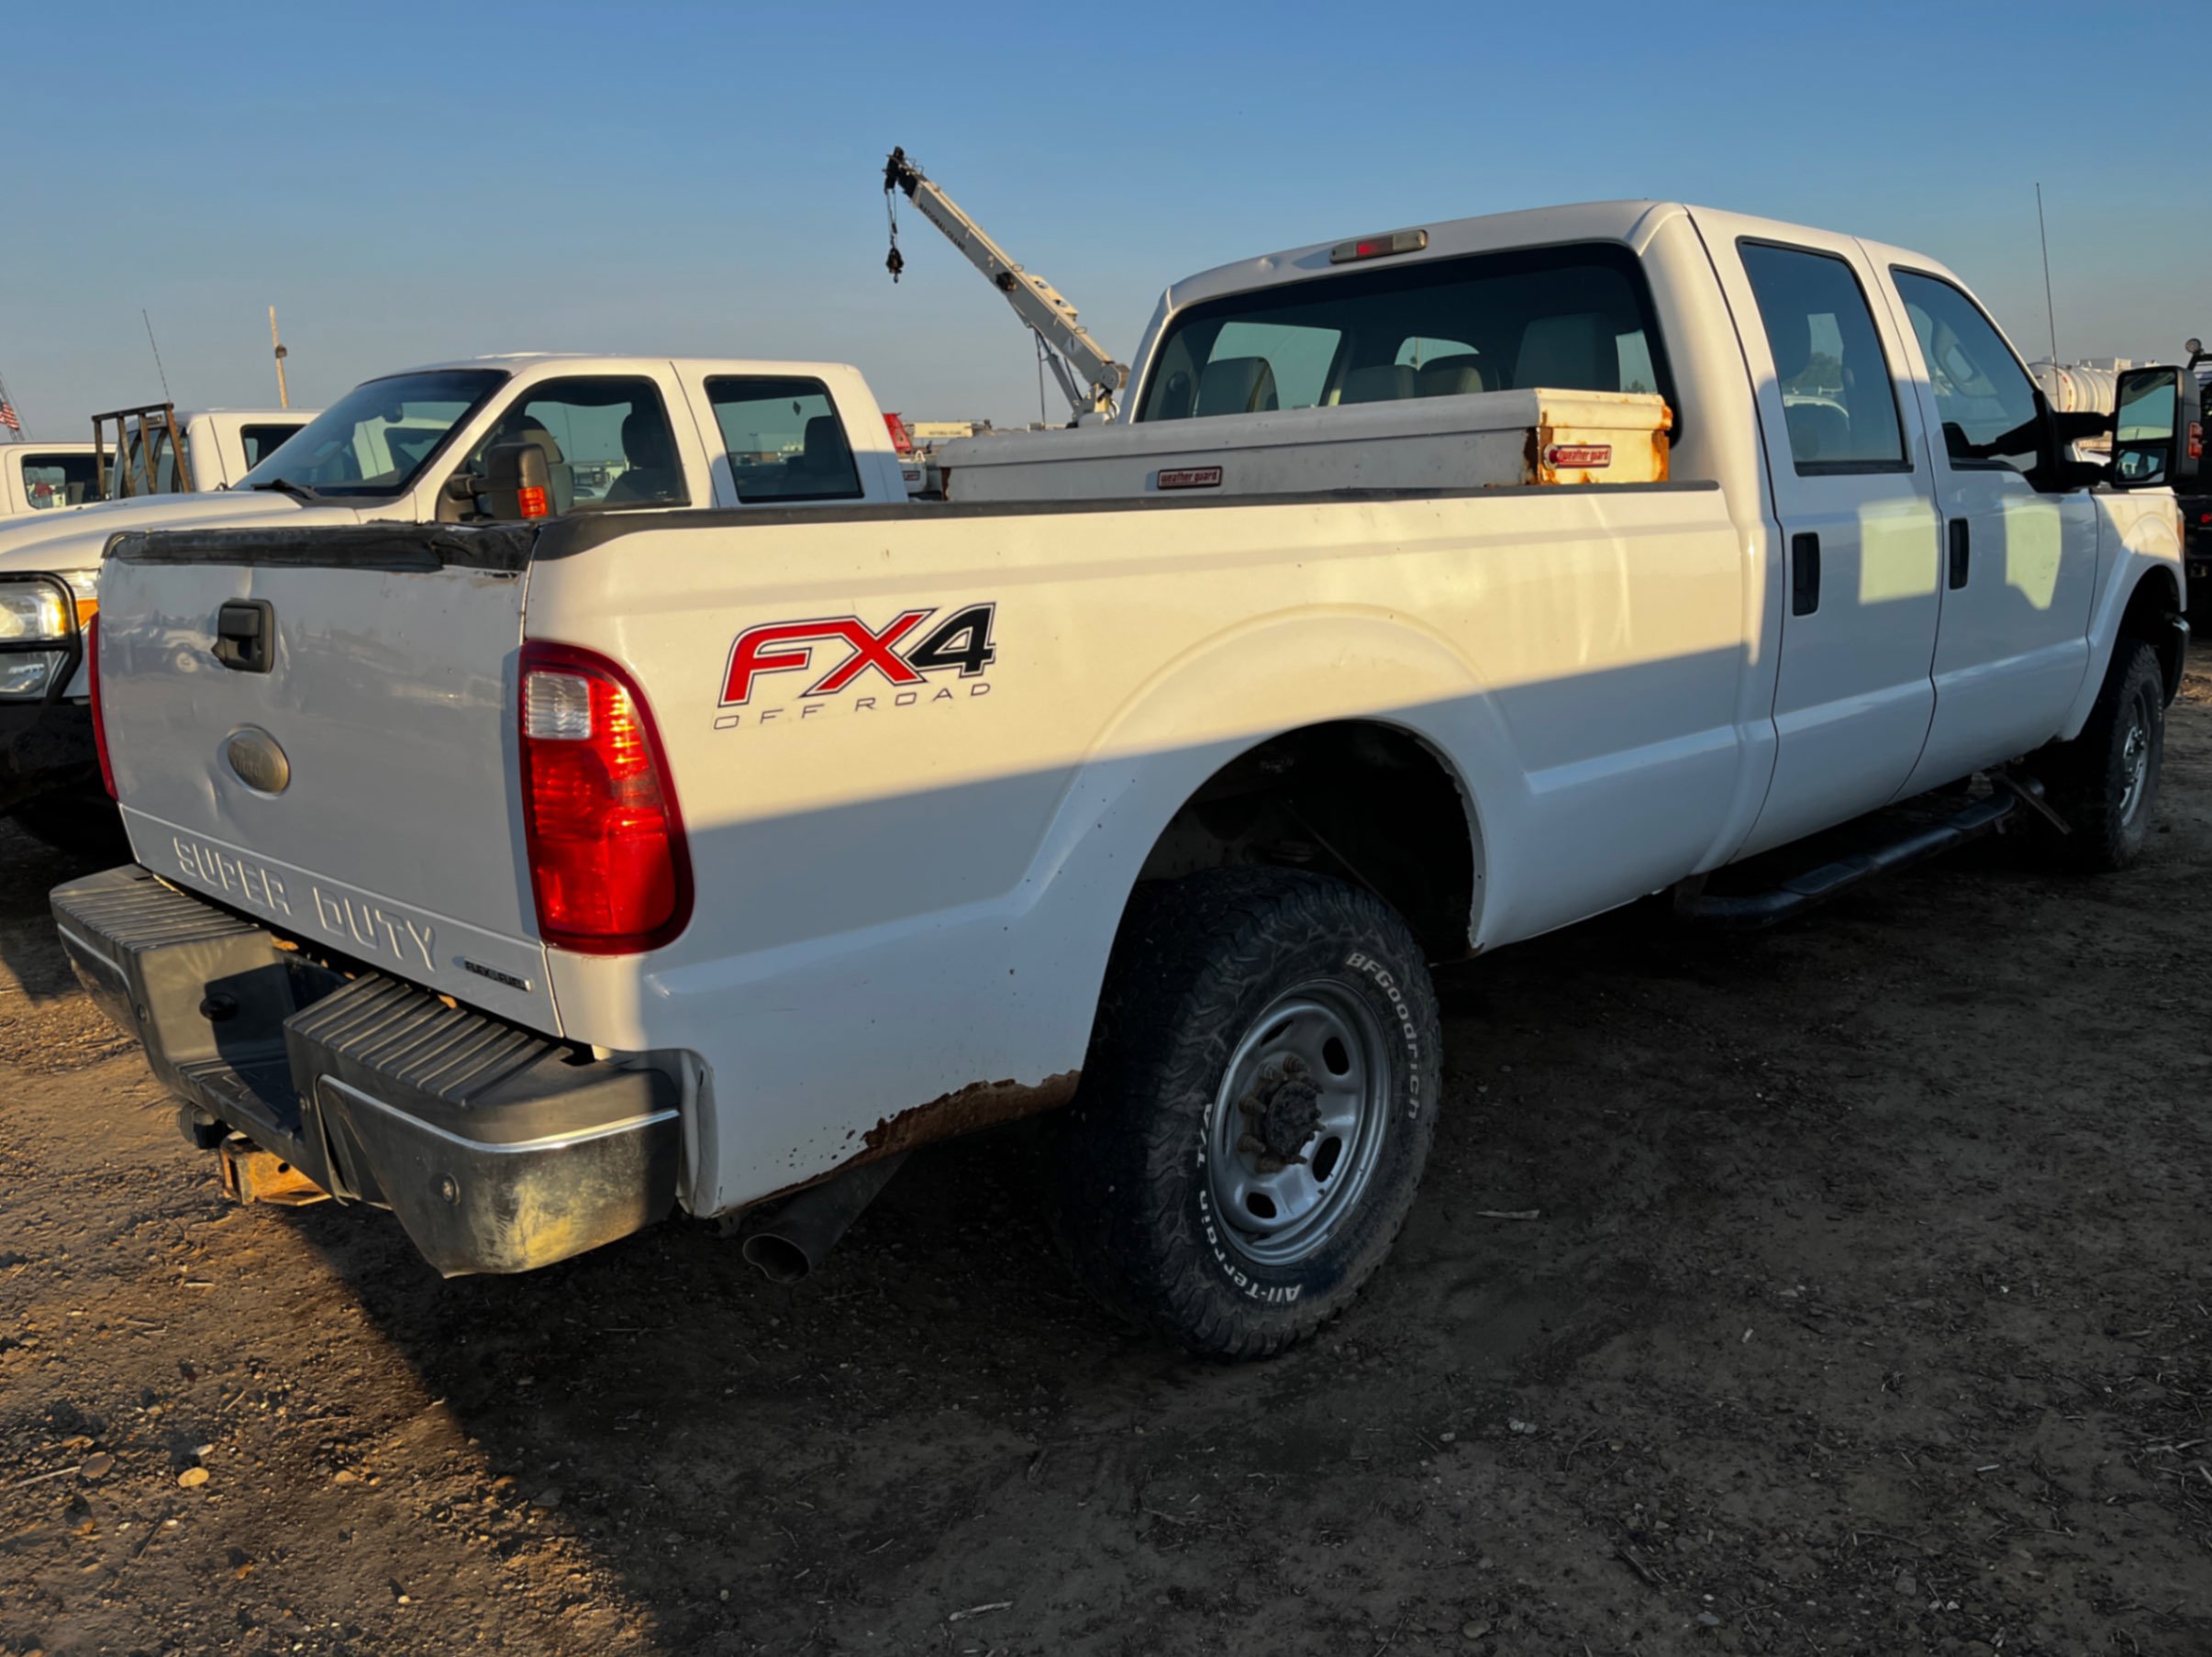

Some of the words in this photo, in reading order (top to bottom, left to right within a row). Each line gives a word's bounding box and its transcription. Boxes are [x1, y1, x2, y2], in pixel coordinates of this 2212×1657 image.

[1161, 471, 1194, 483] weather
[1195, 469, 1218, 483] guard
[717, 602, 996, 707] FX4
[173, 836, 292, 917] SUPER
[313, 885, 436, 973] DUTY
[1346, 952, 1419, 1119] BFGoodrich
[1199, 1190, 1301, 1303] All-Terrain
